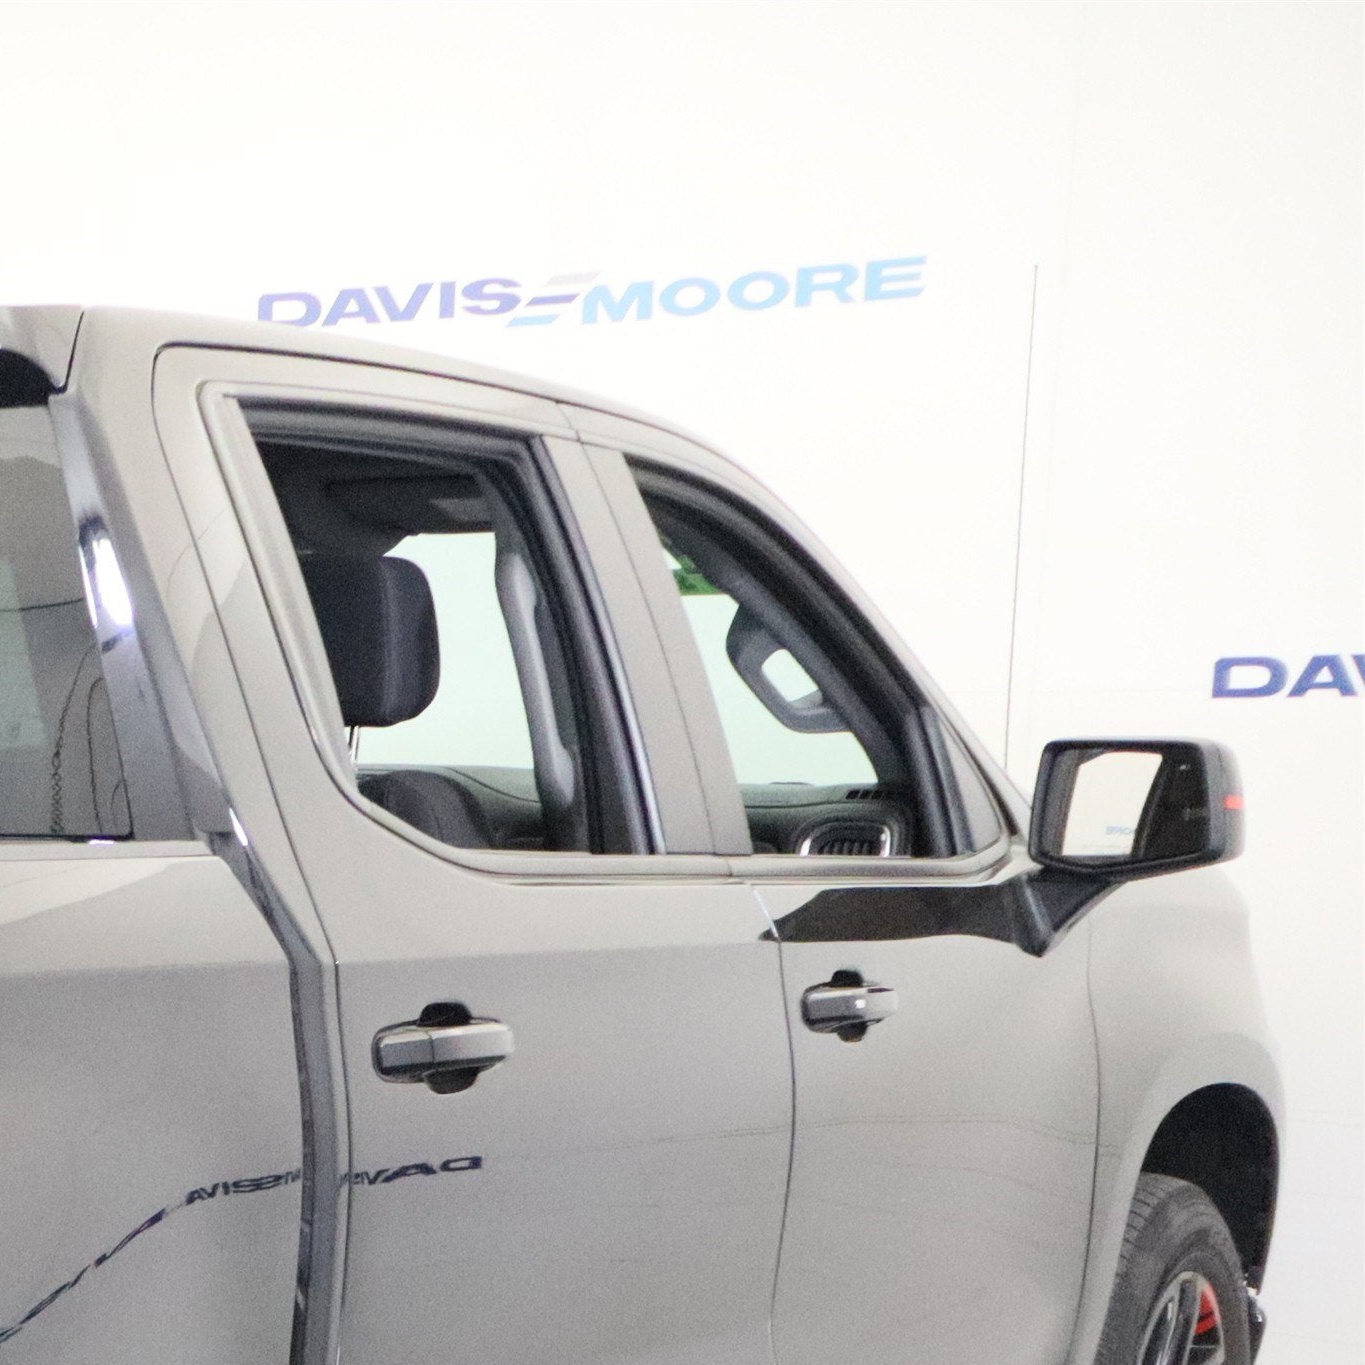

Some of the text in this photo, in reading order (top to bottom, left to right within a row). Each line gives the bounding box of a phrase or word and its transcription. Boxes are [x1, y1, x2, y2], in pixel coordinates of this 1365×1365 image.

[257, 254, 927, 328] DAVIS MOORE
[1212, 653, 1365, 698] DA
